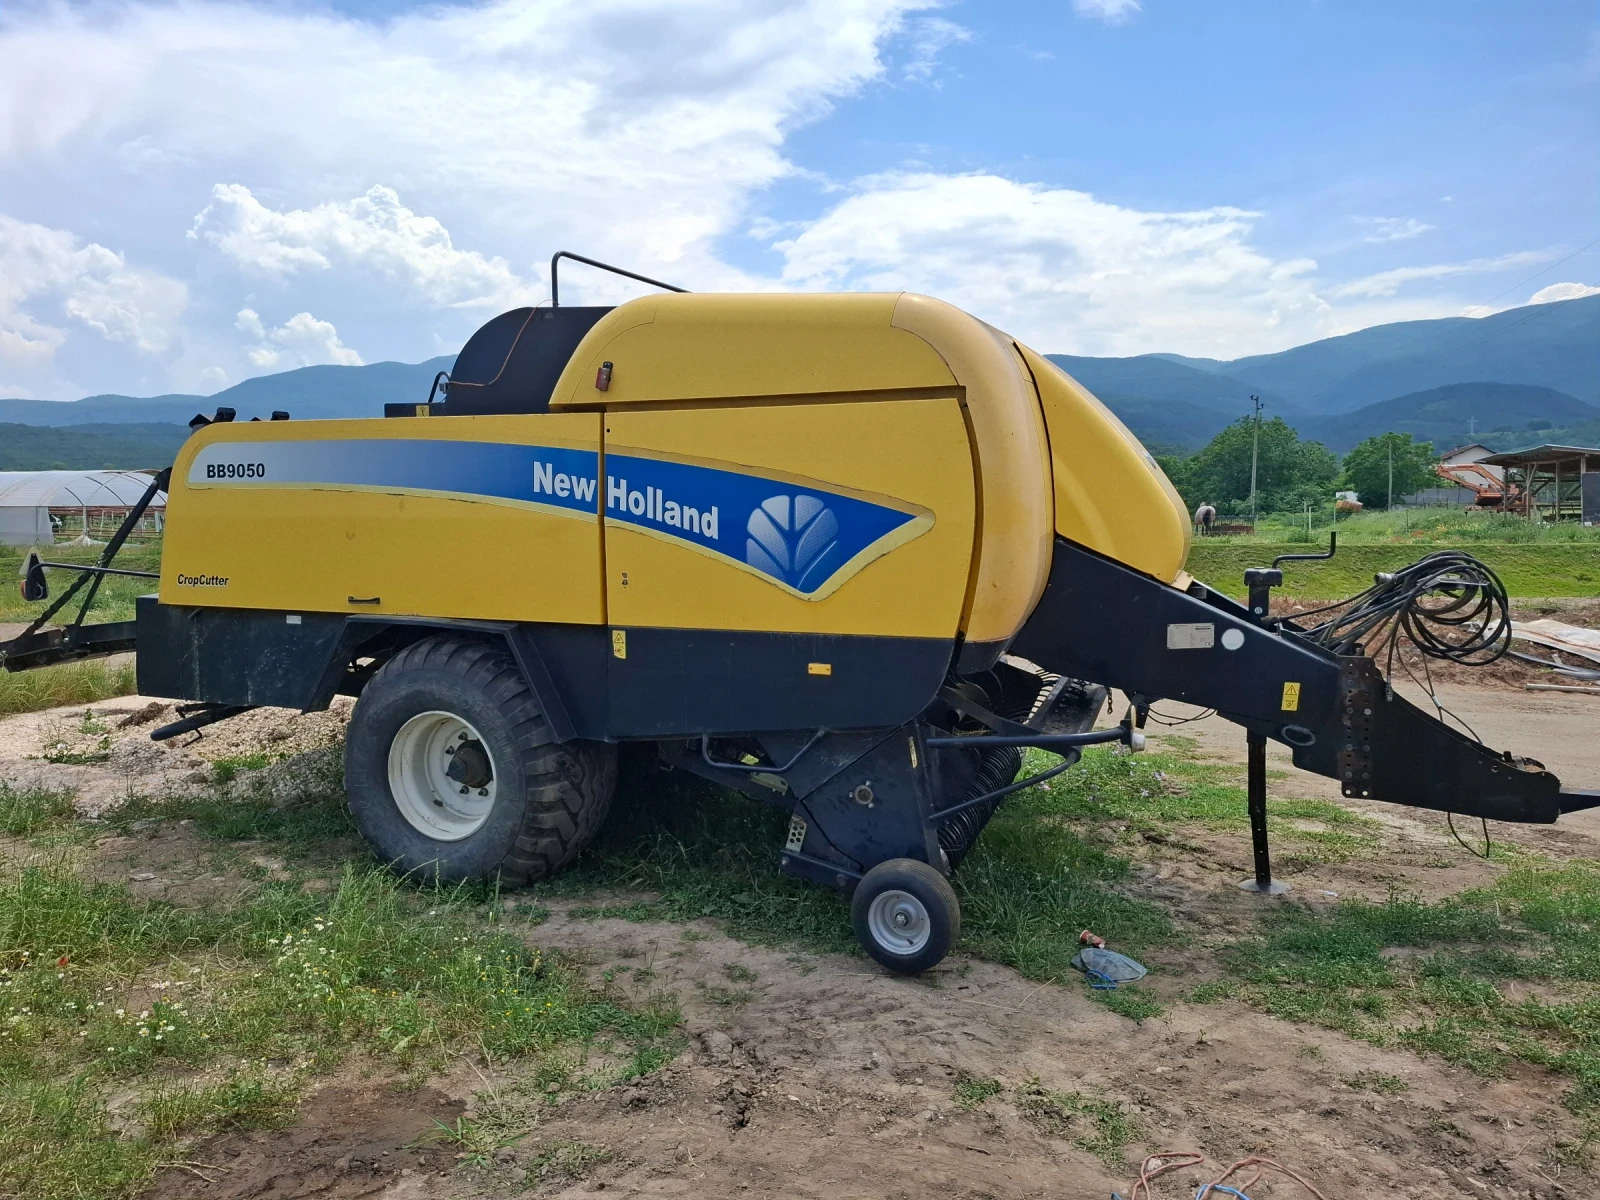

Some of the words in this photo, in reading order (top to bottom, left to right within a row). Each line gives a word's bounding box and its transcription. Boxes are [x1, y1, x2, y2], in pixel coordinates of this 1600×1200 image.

[206, 463, 265, 478] BB9050
[533, 461, 596, 502] New
[607, 475, 719, 540] Holland
[177, 573, 229, 588] CropCutter
